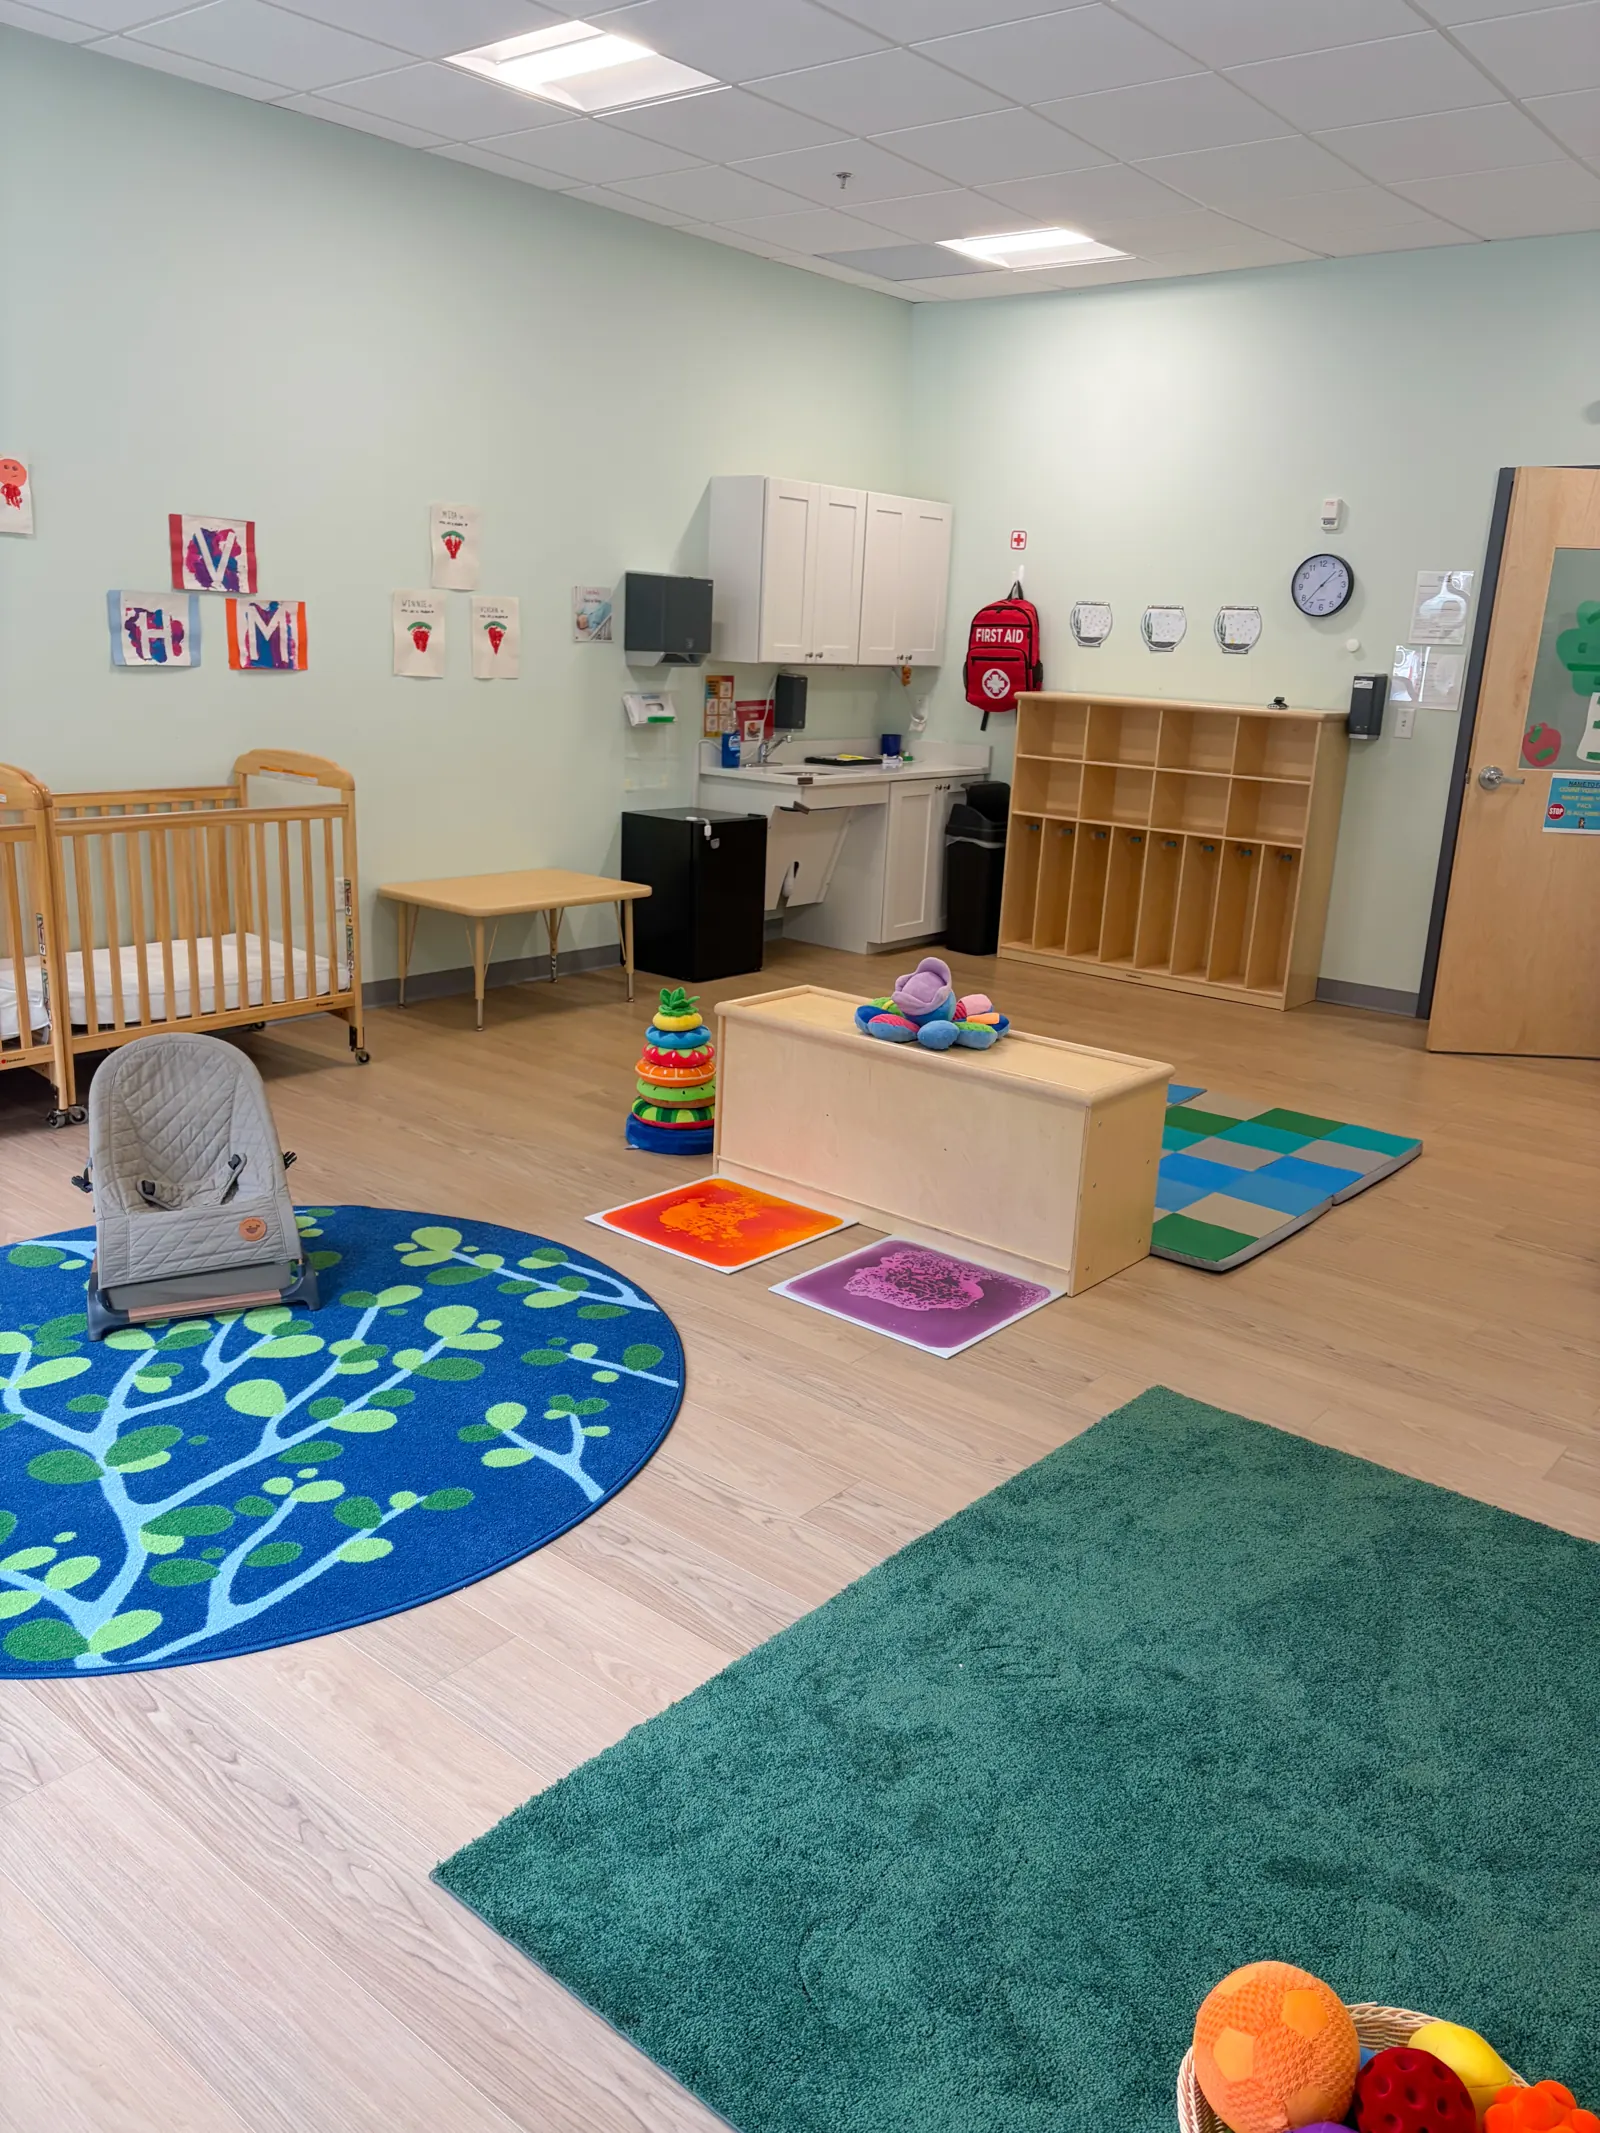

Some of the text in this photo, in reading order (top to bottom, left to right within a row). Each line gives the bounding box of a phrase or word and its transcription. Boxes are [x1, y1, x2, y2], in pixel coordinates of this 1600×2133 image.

[193, 527, 237, 584] V
[139, 609, 173, 660] H
[248, 604, 289, 662] M
[976, 628, 1024, 644] FIRST AID
[1549, 807, 1564, 815] STOP
